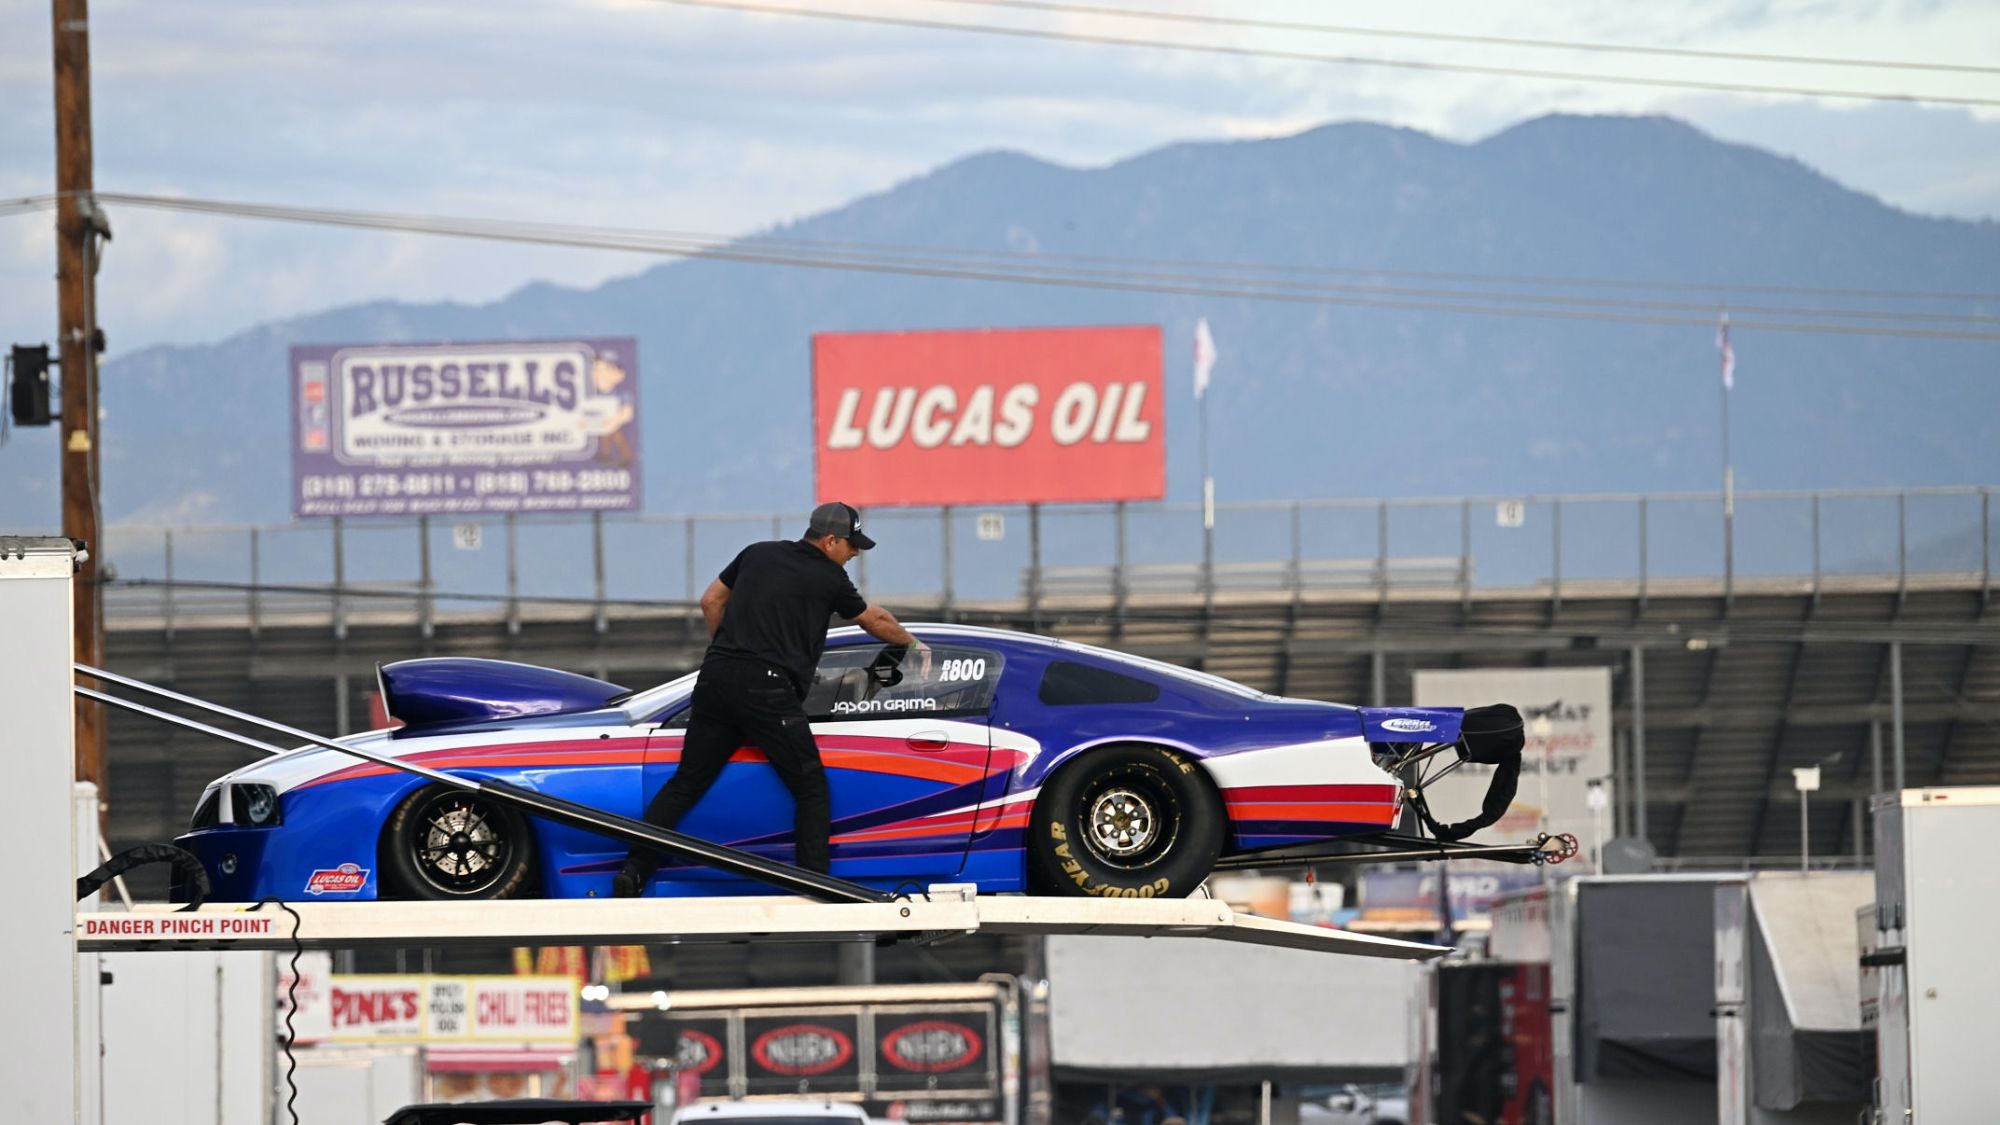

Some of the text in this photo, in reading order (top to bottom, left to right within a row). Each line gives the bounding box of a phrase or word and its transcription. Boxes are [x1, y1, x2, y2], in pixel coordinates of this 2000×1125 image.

[350, 359, 578, 418] RUSSELLS
[826, 381, 1151, 449] LUCAS OIL
[949, 658, 985, 681] 800
[830, 698, 936, 714] JASON GRIMA
[1050, 821, 1170, 898] GOODYEAR
[313, 874, 360, 884] LUCAS OIL
[87, 919, 271, 934] DANGER PINCH POINT
[330, 985, 419, 1028] PINK'S
[477, 989, 569, 1025] CHILI FRIES
[766, 1031, 838, 1065] NHRA
[895, 1029, 967, 1064] NHRA
